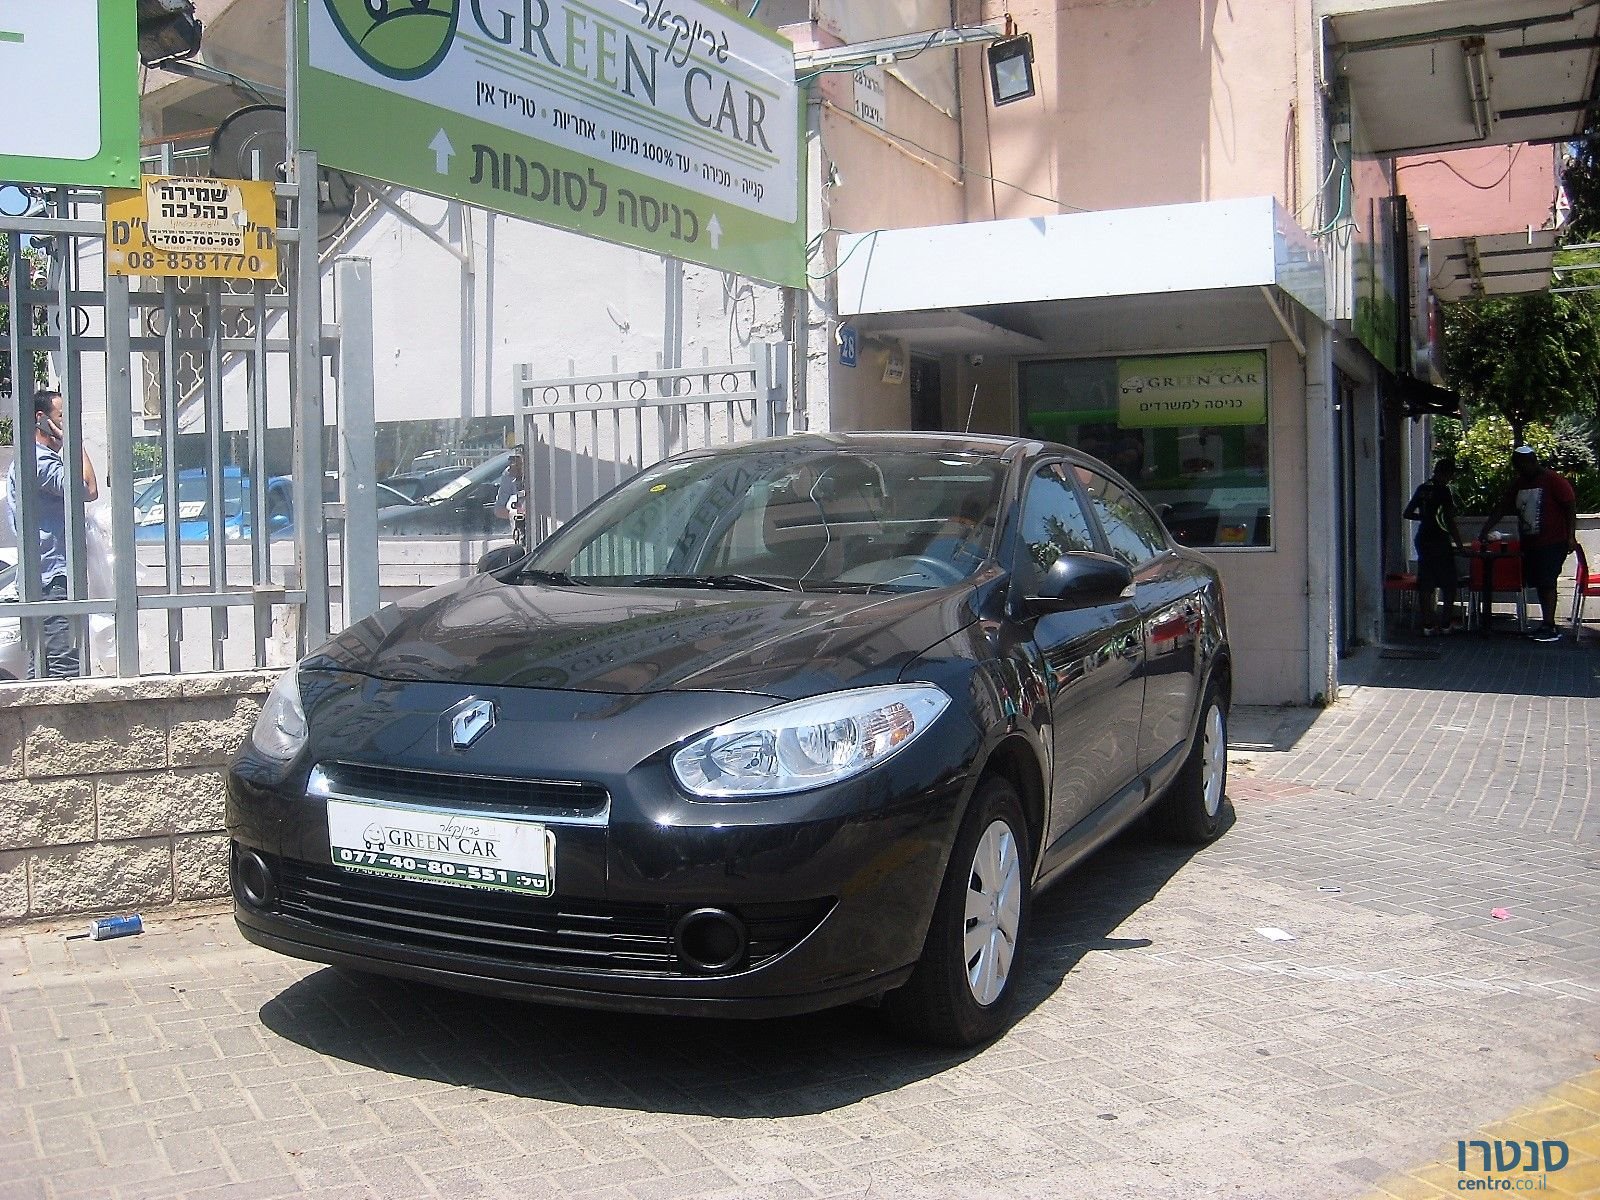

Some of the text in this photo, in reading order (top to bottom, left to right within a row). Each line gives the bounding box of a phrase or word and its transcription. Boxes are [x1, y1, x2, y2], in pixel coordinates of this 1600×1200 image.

[471, 0, 773, 153] GREEN CAR
[476, 80, 764, 202] קנייה מכירה עד 100% מימון אחריות טרייד אין
[161, 186, 228, 203] שמירה
[469, 143, 699, 244] כניסה לסוכנות
[161, 202, 228, 219] כהלכה
[151, 235, 241, 247] 1-700-700-989
[127, 251, 260, 272] 08-8581770
[1220, 373, 1258, 385] CAR
[1139, 399, 1243, 412] כניסה למשרדים
[389, 829, 497, 858] GREEN CAR
[340, 848, 508, 884] 077-40-80-551
[516, 876, 545, 889] טל:
